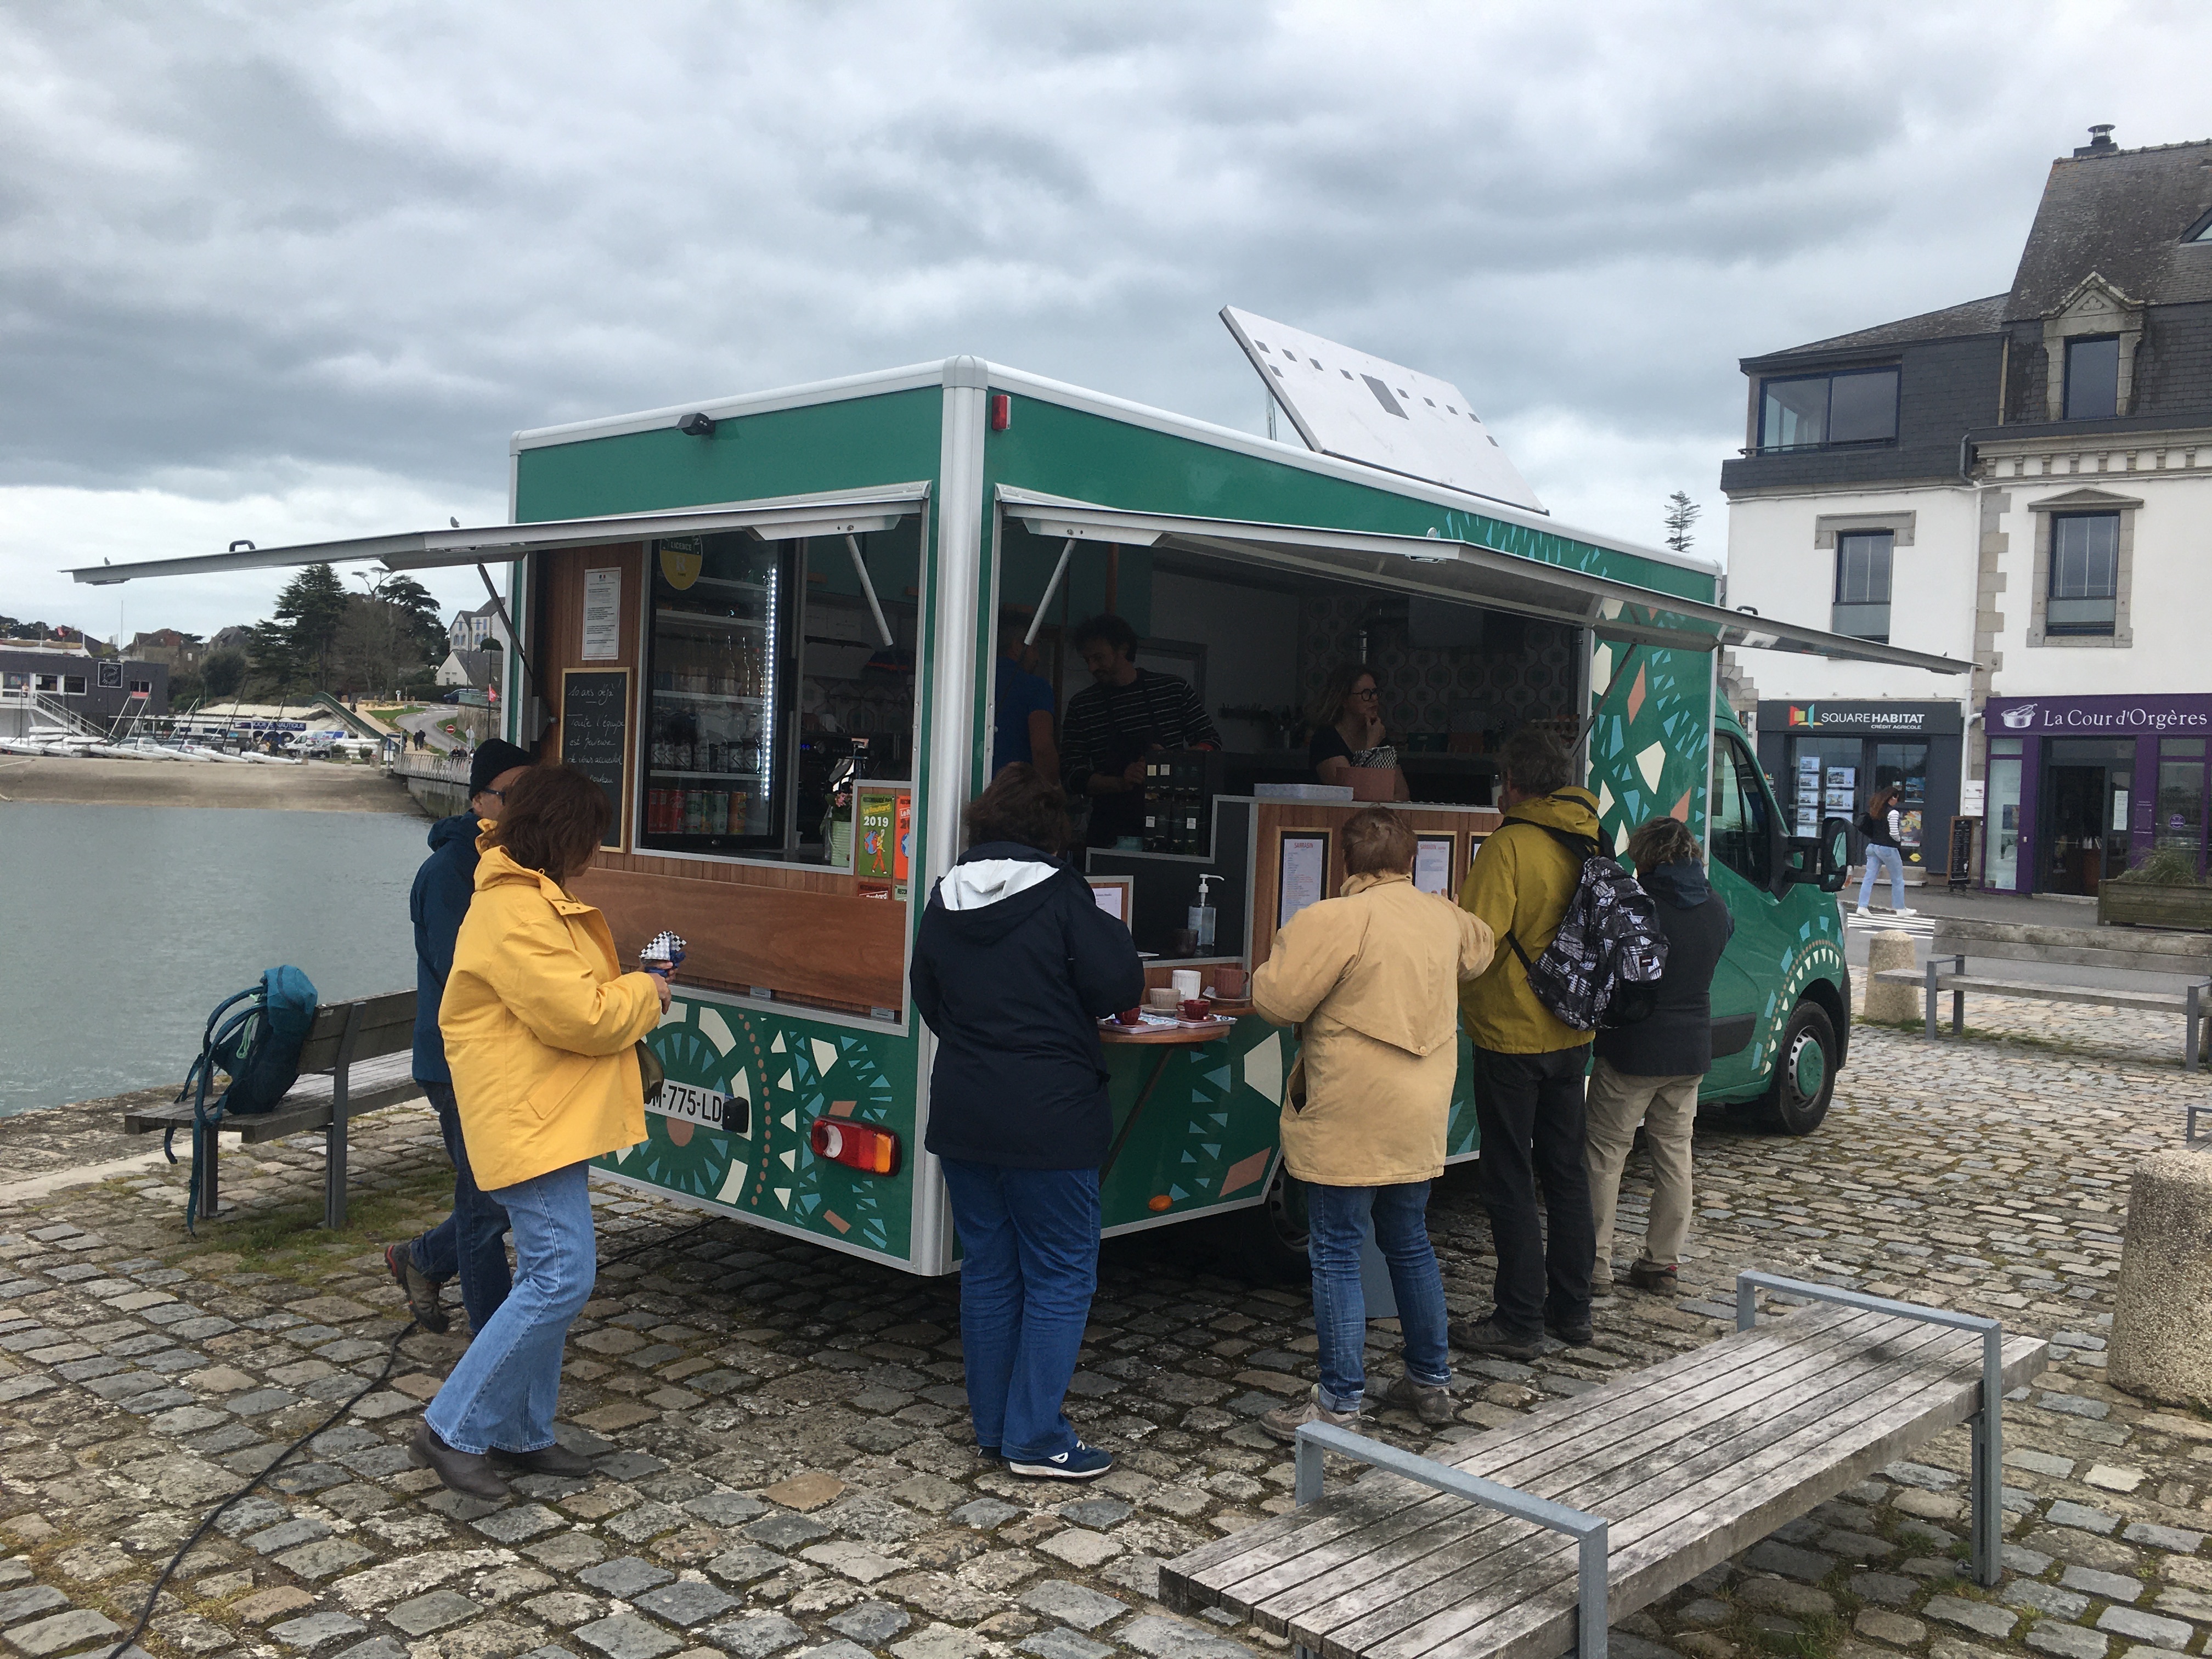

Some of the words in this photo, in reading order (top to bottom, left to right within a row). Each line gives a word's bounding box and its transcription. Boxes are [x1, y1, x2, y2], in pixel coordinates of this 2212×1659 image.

[671, 541, 692, 551] LICENCE
[2044, 710, 2063, 726] La
[2068, 709, 2113, 726] Cour
[2116, 708, 2208, 730] d'Orgères
[864, 816, 889, 827] 2019
[646, 1085, 722, 1122] M-775-LD
